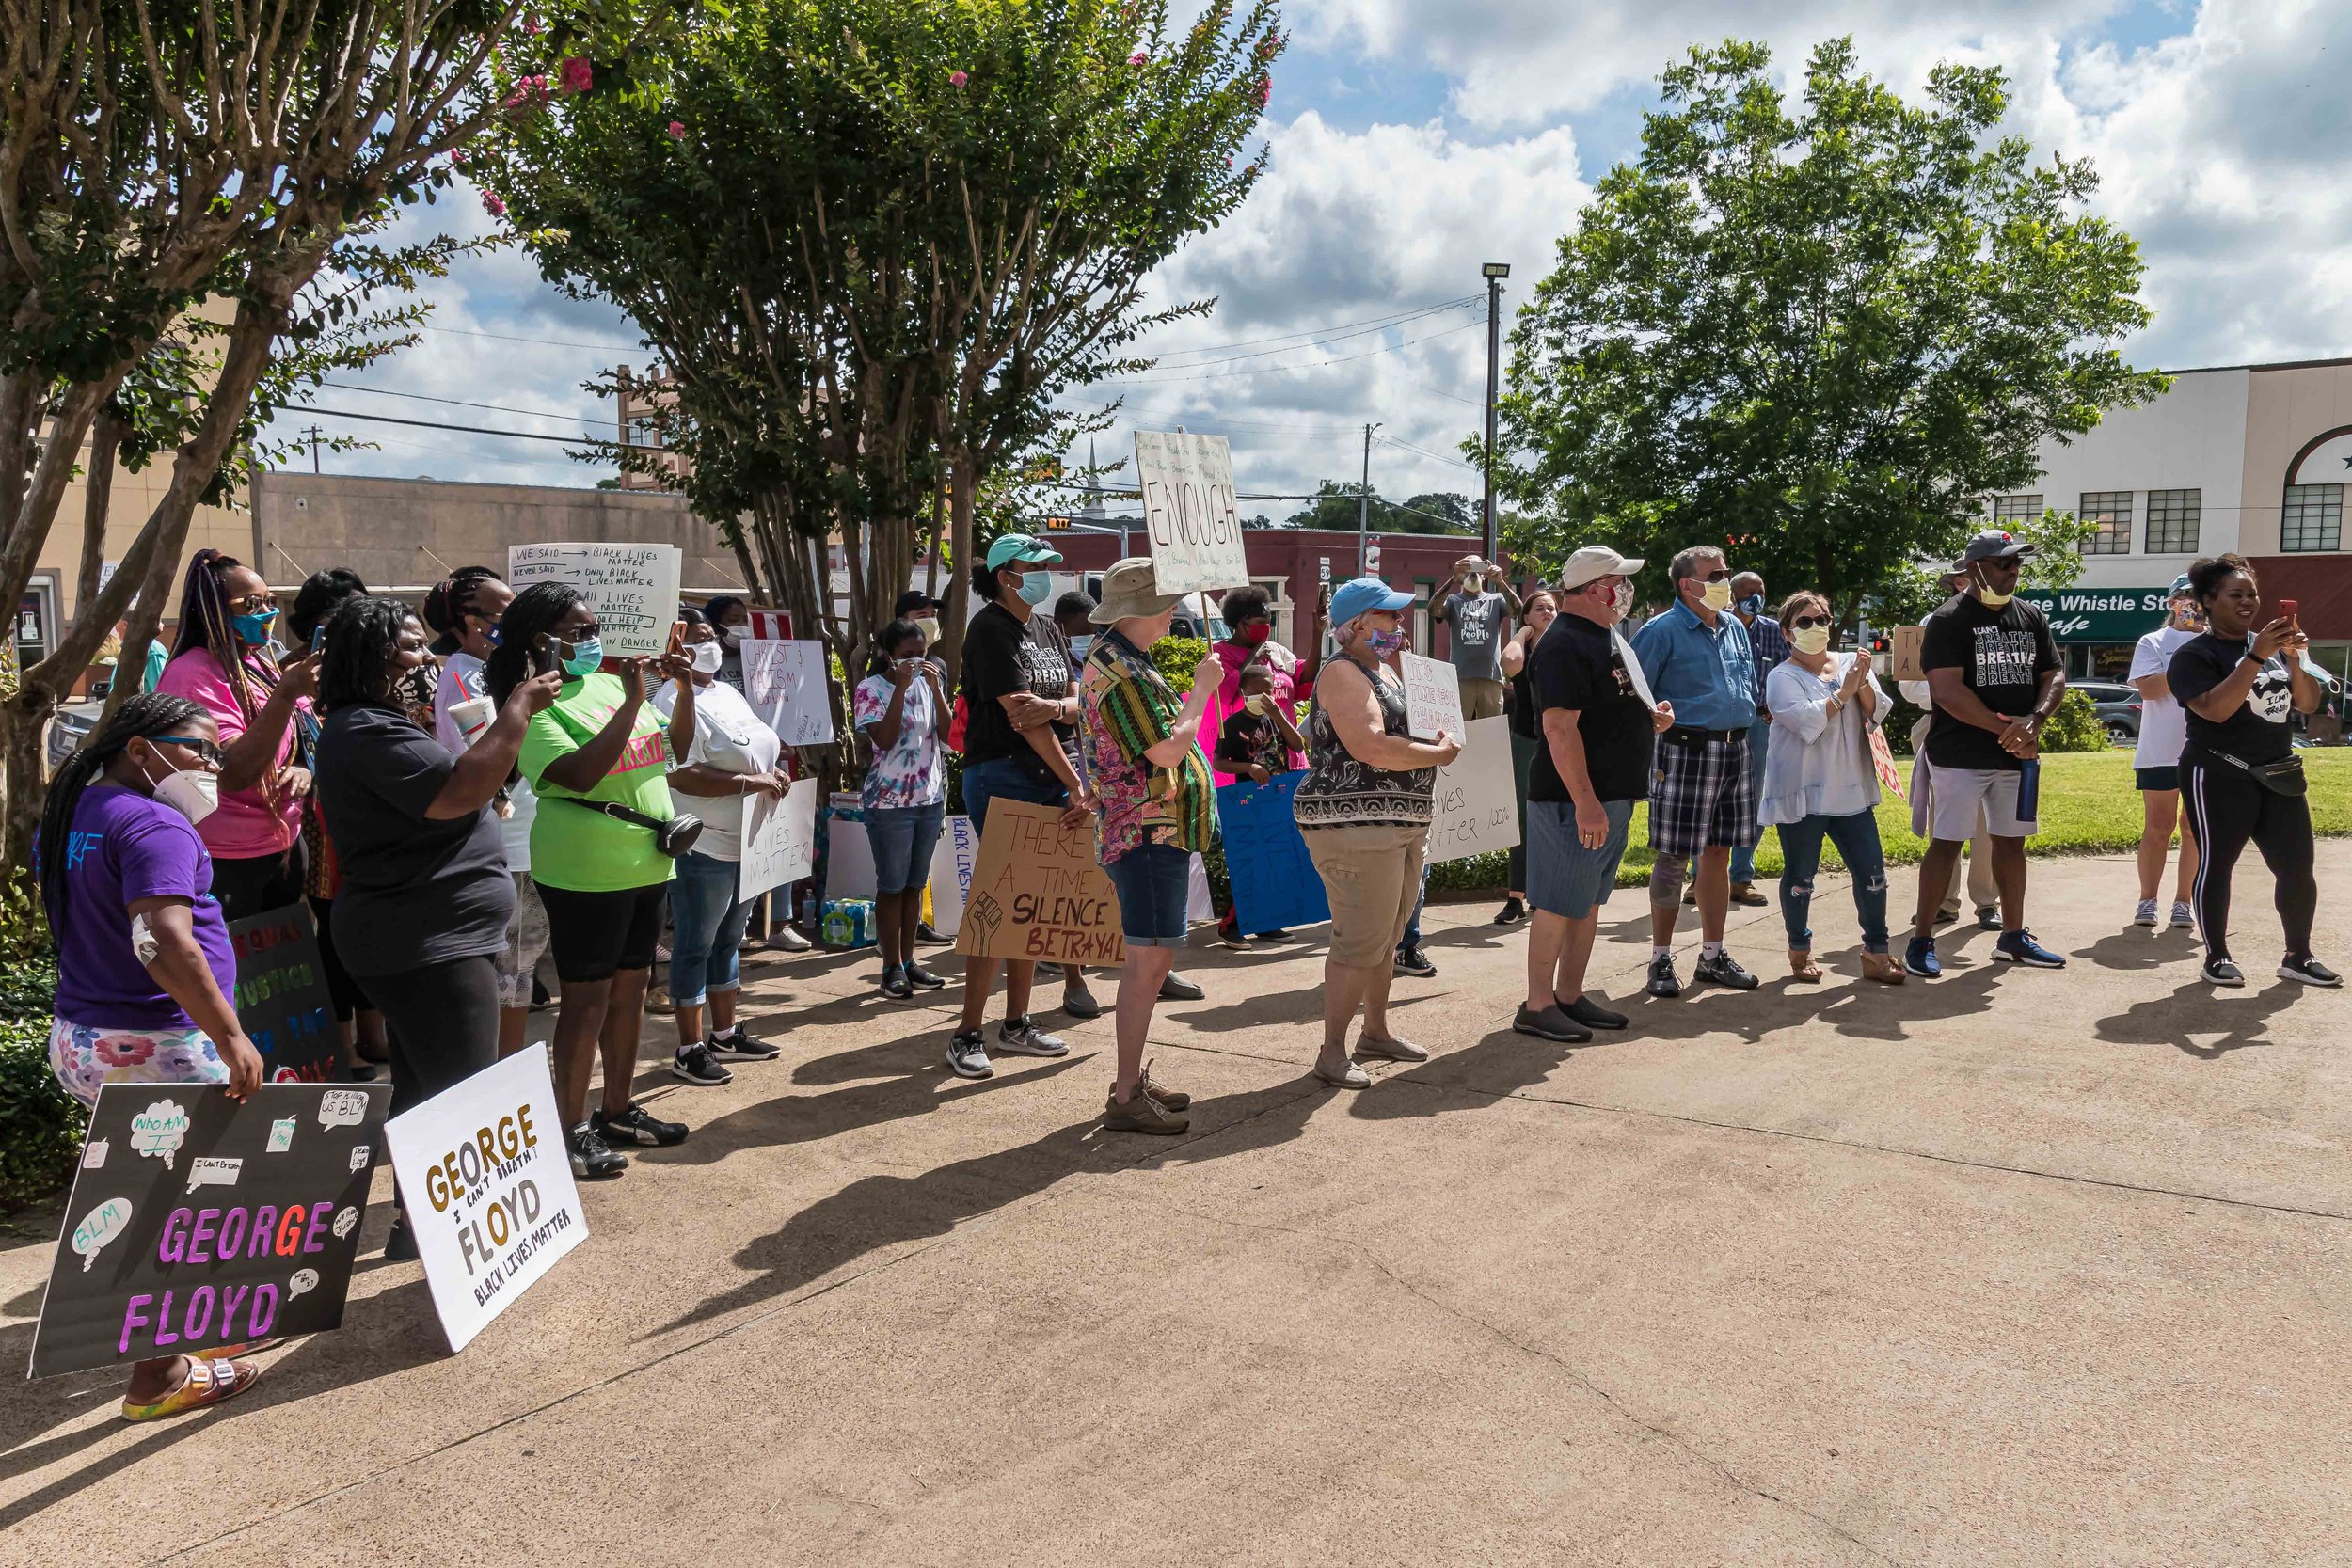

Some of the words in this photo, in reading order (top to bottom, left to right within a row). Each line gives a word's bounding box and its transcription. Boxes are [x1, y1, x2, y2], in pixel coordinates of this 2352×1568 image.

[1147, 481, 1240, 546] ENOUGH
[516, 548, 533, 561] WE
[539, 548, 560, 558] SAID
[607, 559, 645, 568] MATTER
[513, 566, 536, 577] NEVER
[615, 578, 655, 587] MATTER
[1321, 568, 1330, 578] 59
[600, 604, 643, 612] MATTER
[607, 592, 644, 604] LIVES
[2060, 594, 2136, 612] Whistle
[2045, 615, 2090, 636] afe
[606, 638, 617, 646] IN
[621, 638, 660, 648] DANGER
[746, 641, 792, 667] CHRIST
[1977, 651, 2037, 666] BREATHE
[747, 669, 798, 690] RACISM
[1408, 683, 1437, 705] TIME
[1438, 687, 1457, 708] FOR
[1411, 704, 1459, 733] CHANGE
[755, 826, 790, 855] LIVES
[952, 816, 970, 850] BLACK
[750, 841, 809, 884] MATTER
[956, 853, 973, 890] LIVES
[994, 863, 1016, 892] A
[1037, 866, 1094, 895] TIME
[1011, 893, 1109, 925] SILENCE
[1023, 927, 1126, 962] BETRAYAL
[339, 1100, 367, 1116] BLM
[163, 1116, 187, 1131] AM
[425, 1103, 538, 1213] GEORGE
[453, 1209, 461, 1224] I
[466, 1176, 490, 1208] CAN'T
[74, 1203, 121, 1251] BLM
[158, 1201, 334, 1265] GEORGE
[457, 1178, 542, 1276] FLOYD
[473, 1267, 505, 1307] BLACK
[502, 1238, 532, 1278] LIVES
[531, 1207, 572, 1253] MATTER
[119, 1282, 278, 1354] FLOYD
